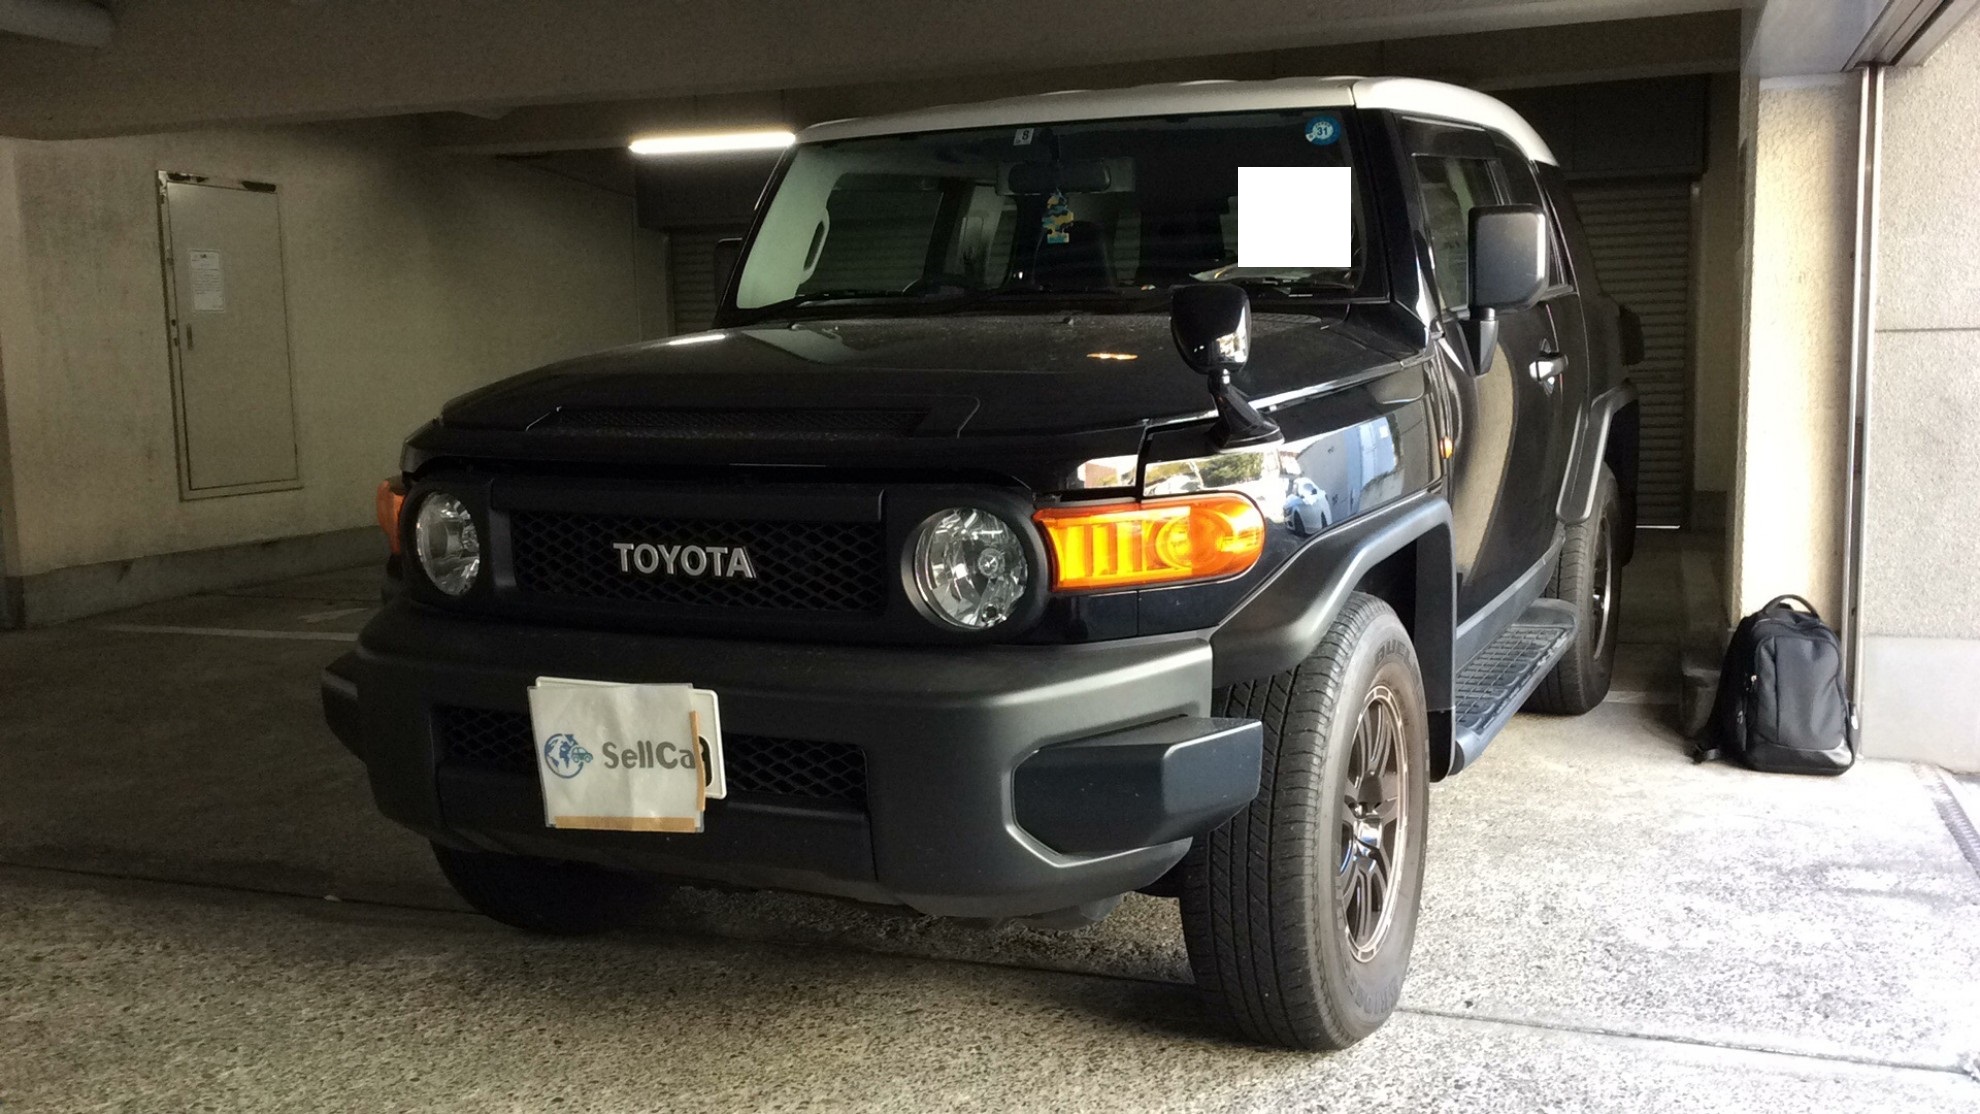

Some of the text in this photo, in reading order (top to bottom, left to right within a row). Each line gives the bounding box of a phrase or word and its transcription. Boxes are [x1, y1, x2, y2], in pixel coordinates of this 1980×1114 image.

[1316, 126, 1328, 136] 31
[613, 543, 755, 579] TOYOTA
[602, 740, 696, 770] SellCa
